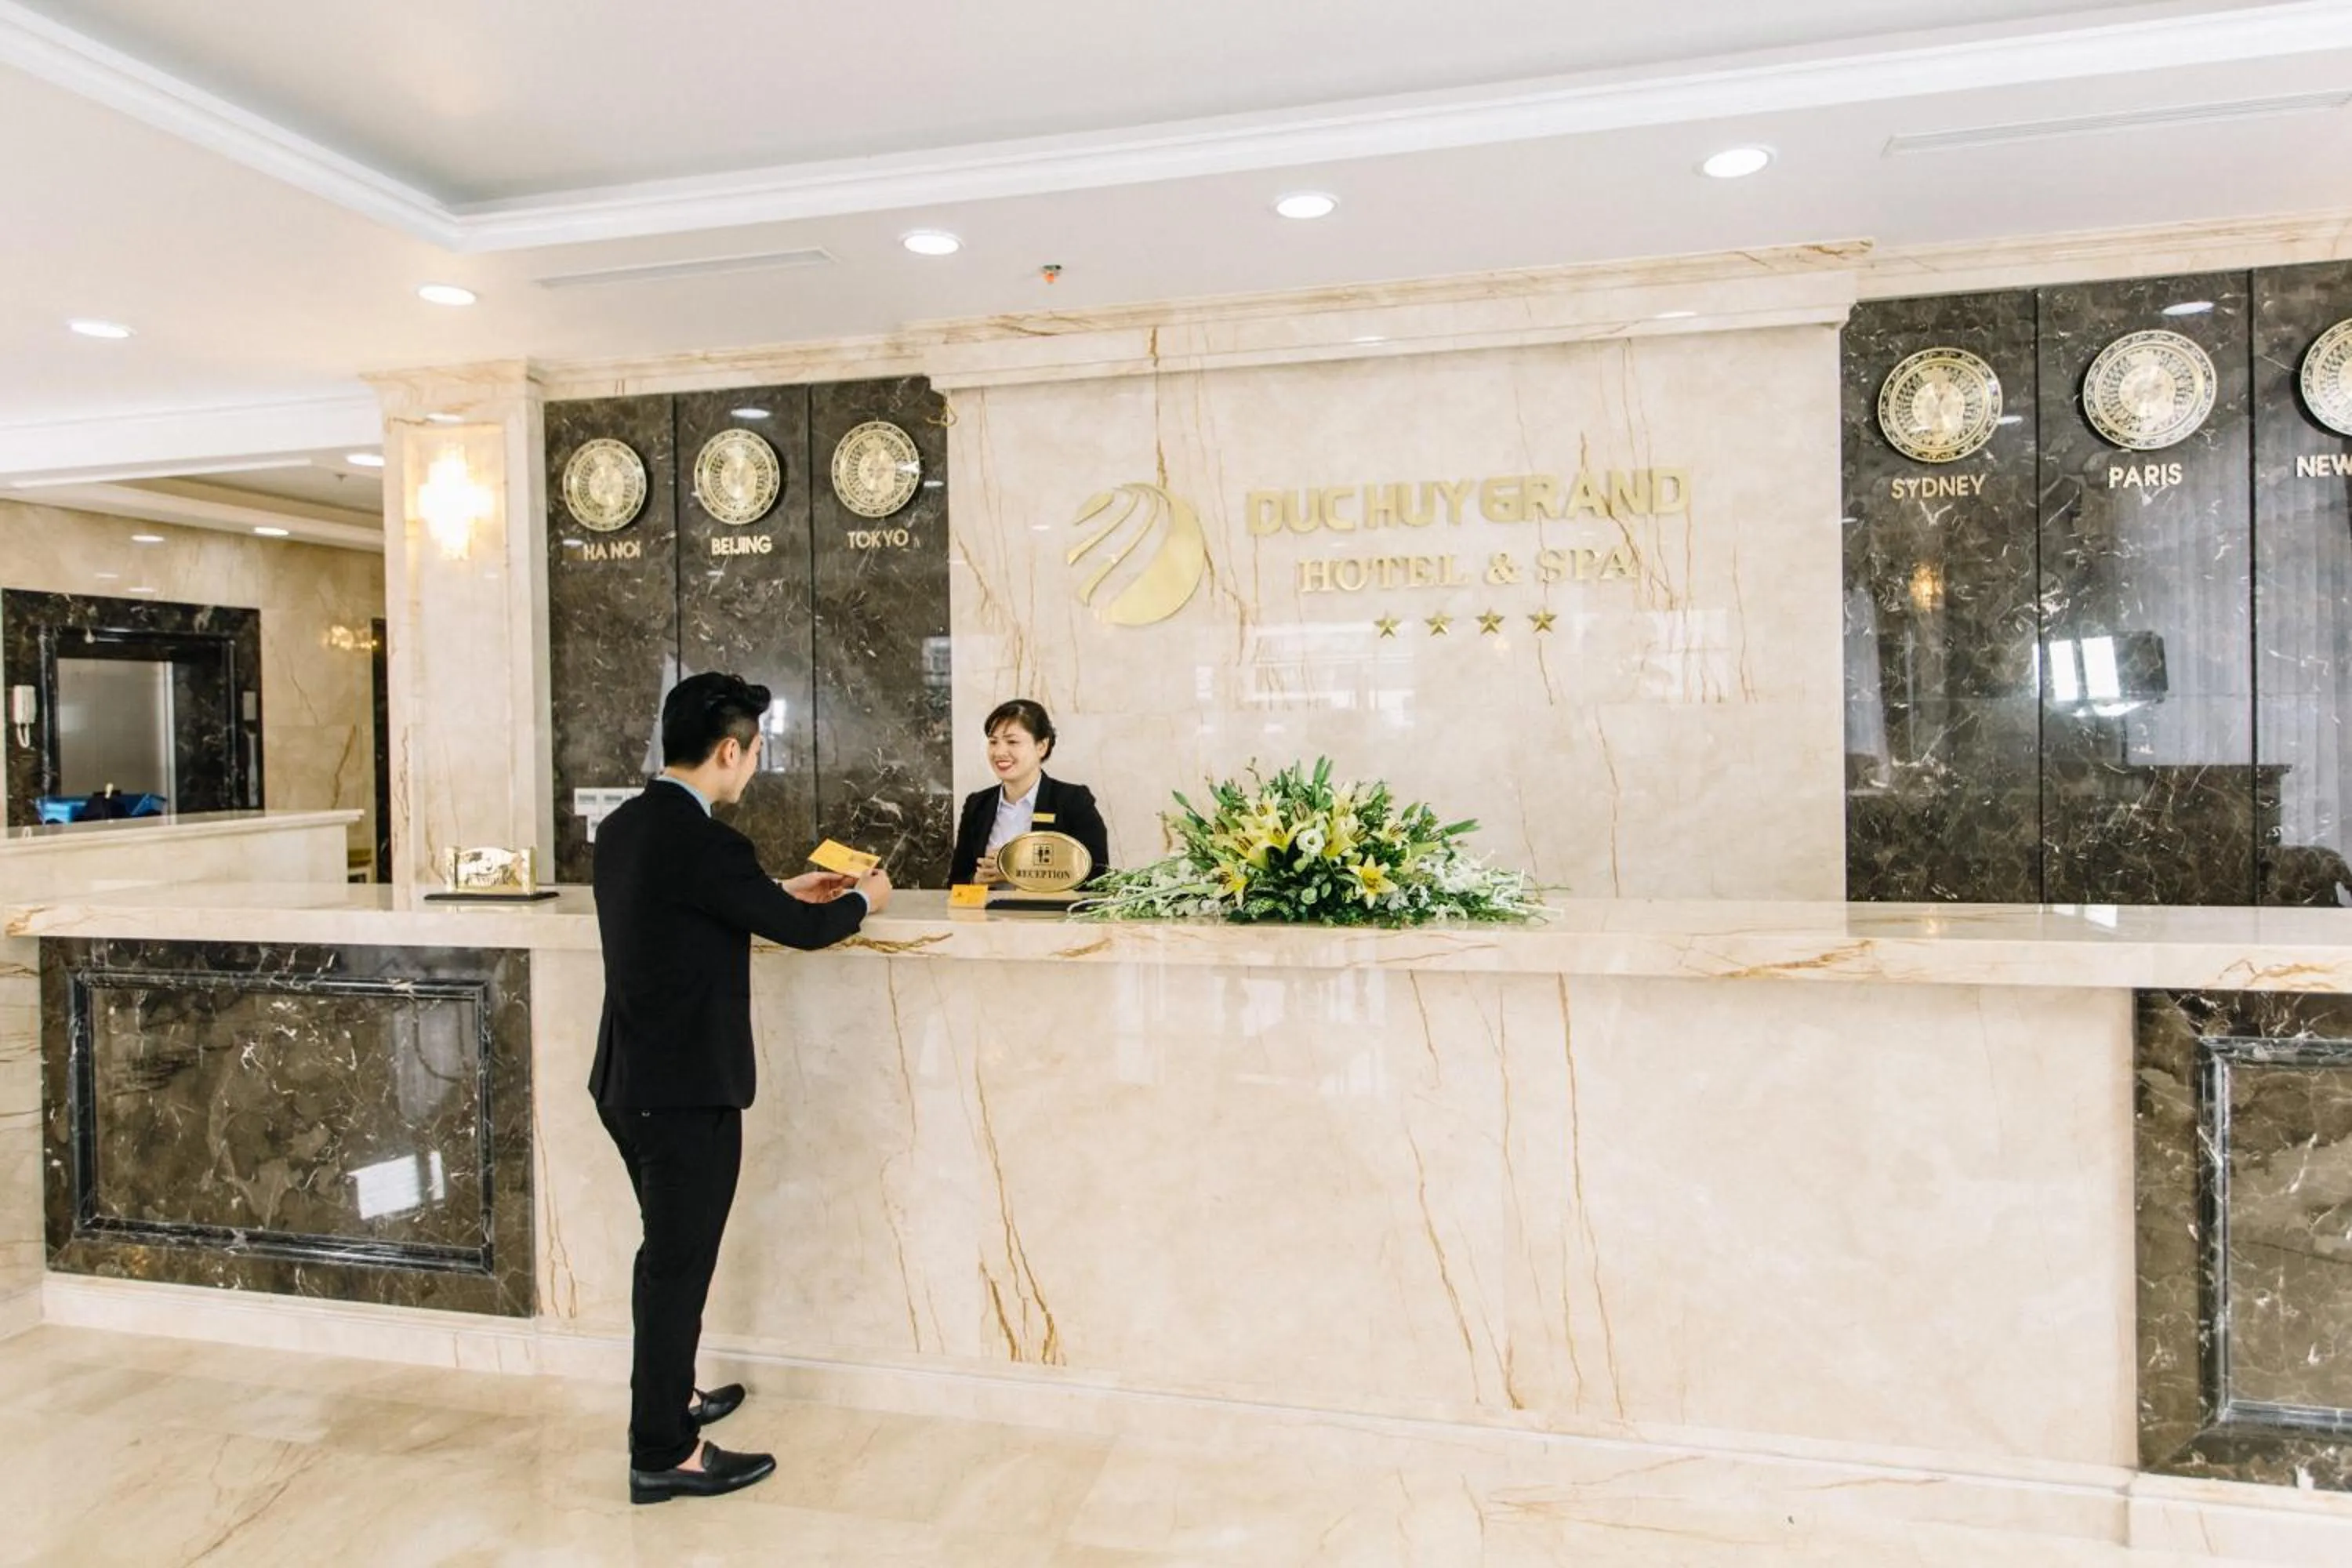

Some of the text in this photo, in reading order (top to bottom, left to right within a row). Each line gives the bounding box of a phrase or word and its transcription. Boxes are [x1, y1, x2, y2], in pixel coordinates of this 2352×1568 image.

[2108, 463, 2183, 488] PARIS
[2296, 453, 2352, 477] NEW
[1891, 474, 1986, 499] SYDNEY
[1246, 466, 1690, 536] DUC HUY GRAND
[711, 535, 772, 555] BEIJING
[847, 528, 909, 549] TOKYO
[1298, 549, 1640, 593] HOTEL & SPA
[1015, 869, 1071, 879] RECEPTION
